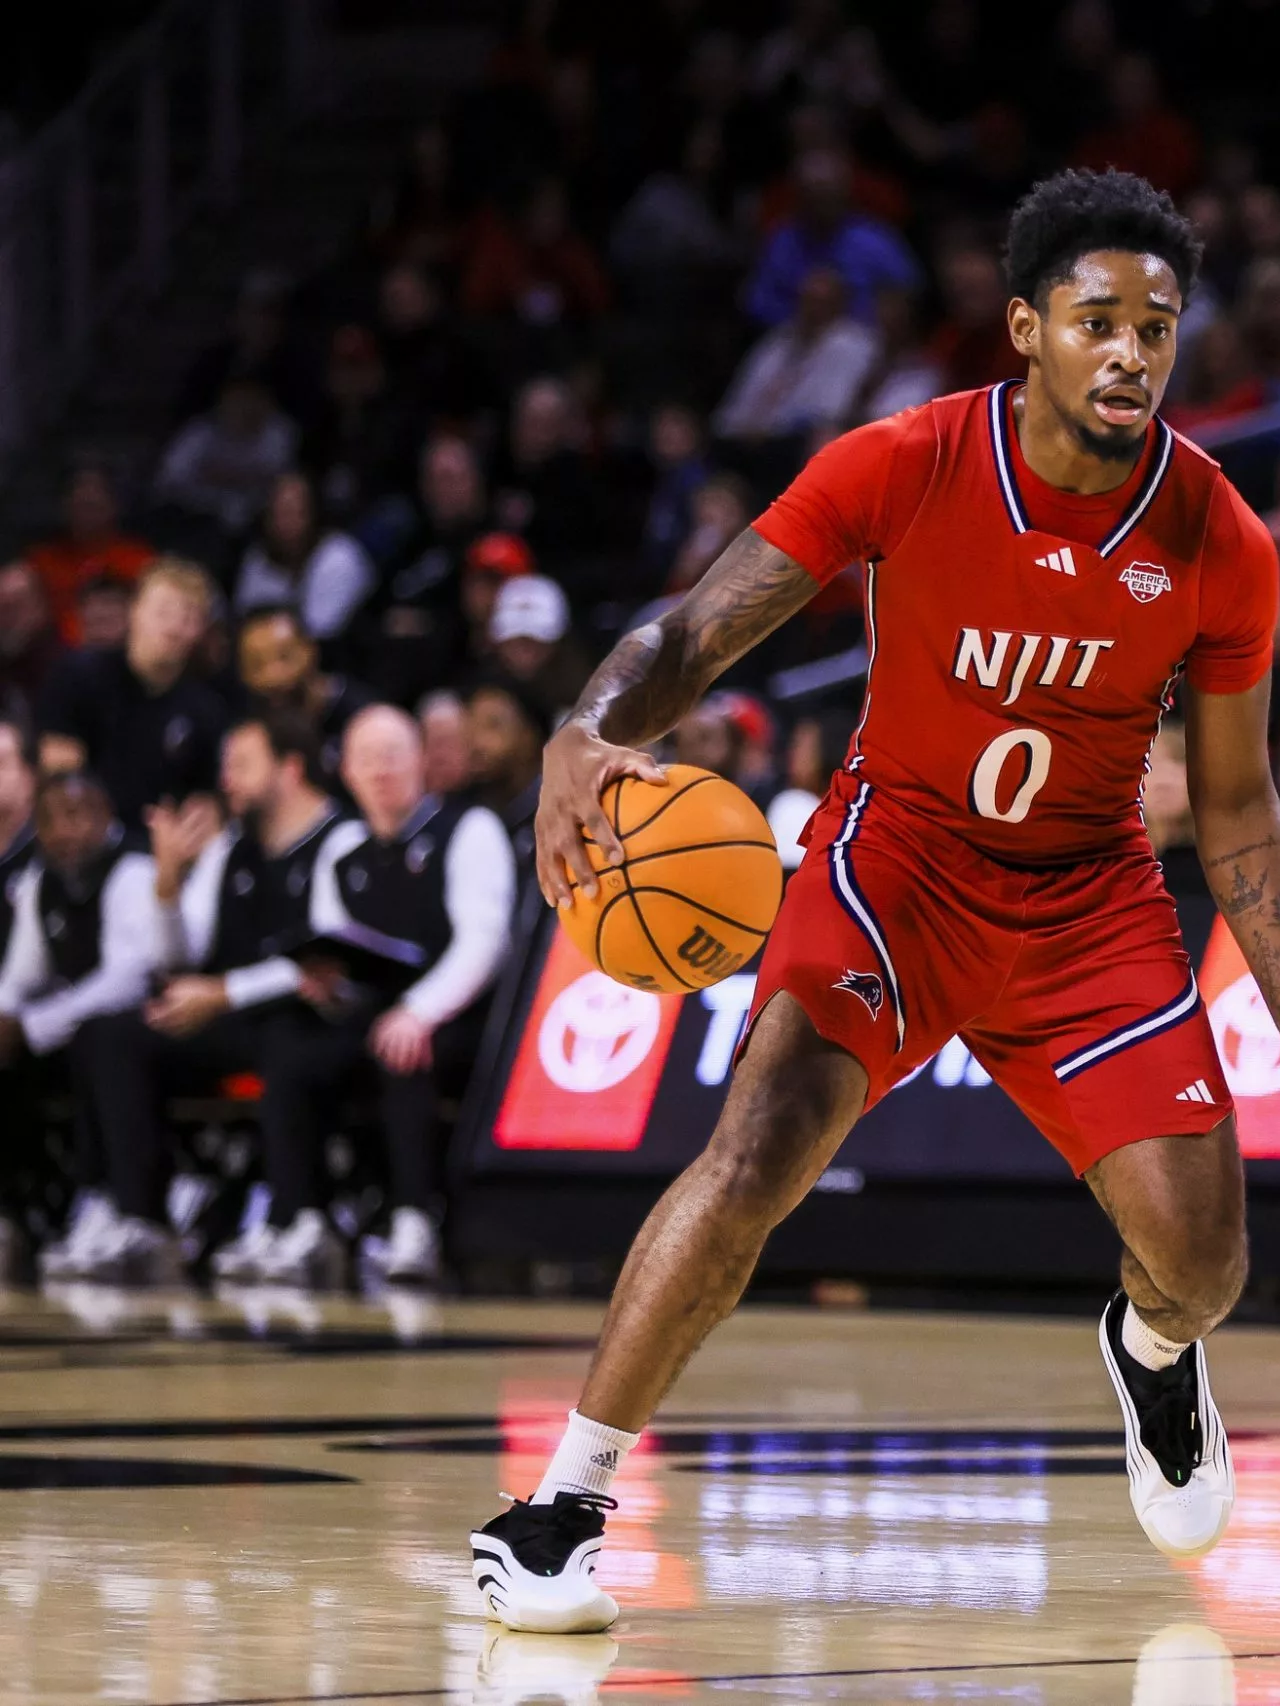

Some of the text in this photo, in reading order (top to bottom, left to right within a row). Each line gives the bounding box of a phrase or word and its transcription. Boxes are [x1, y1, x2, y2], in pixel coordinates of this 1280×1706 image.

[1121, 570, 1170, 590] AMERICA
[1131, 581, 1158, 593] EAST
[953, 626, 1116, 706] NJIT
[967, 728, 1052, 824] 0
